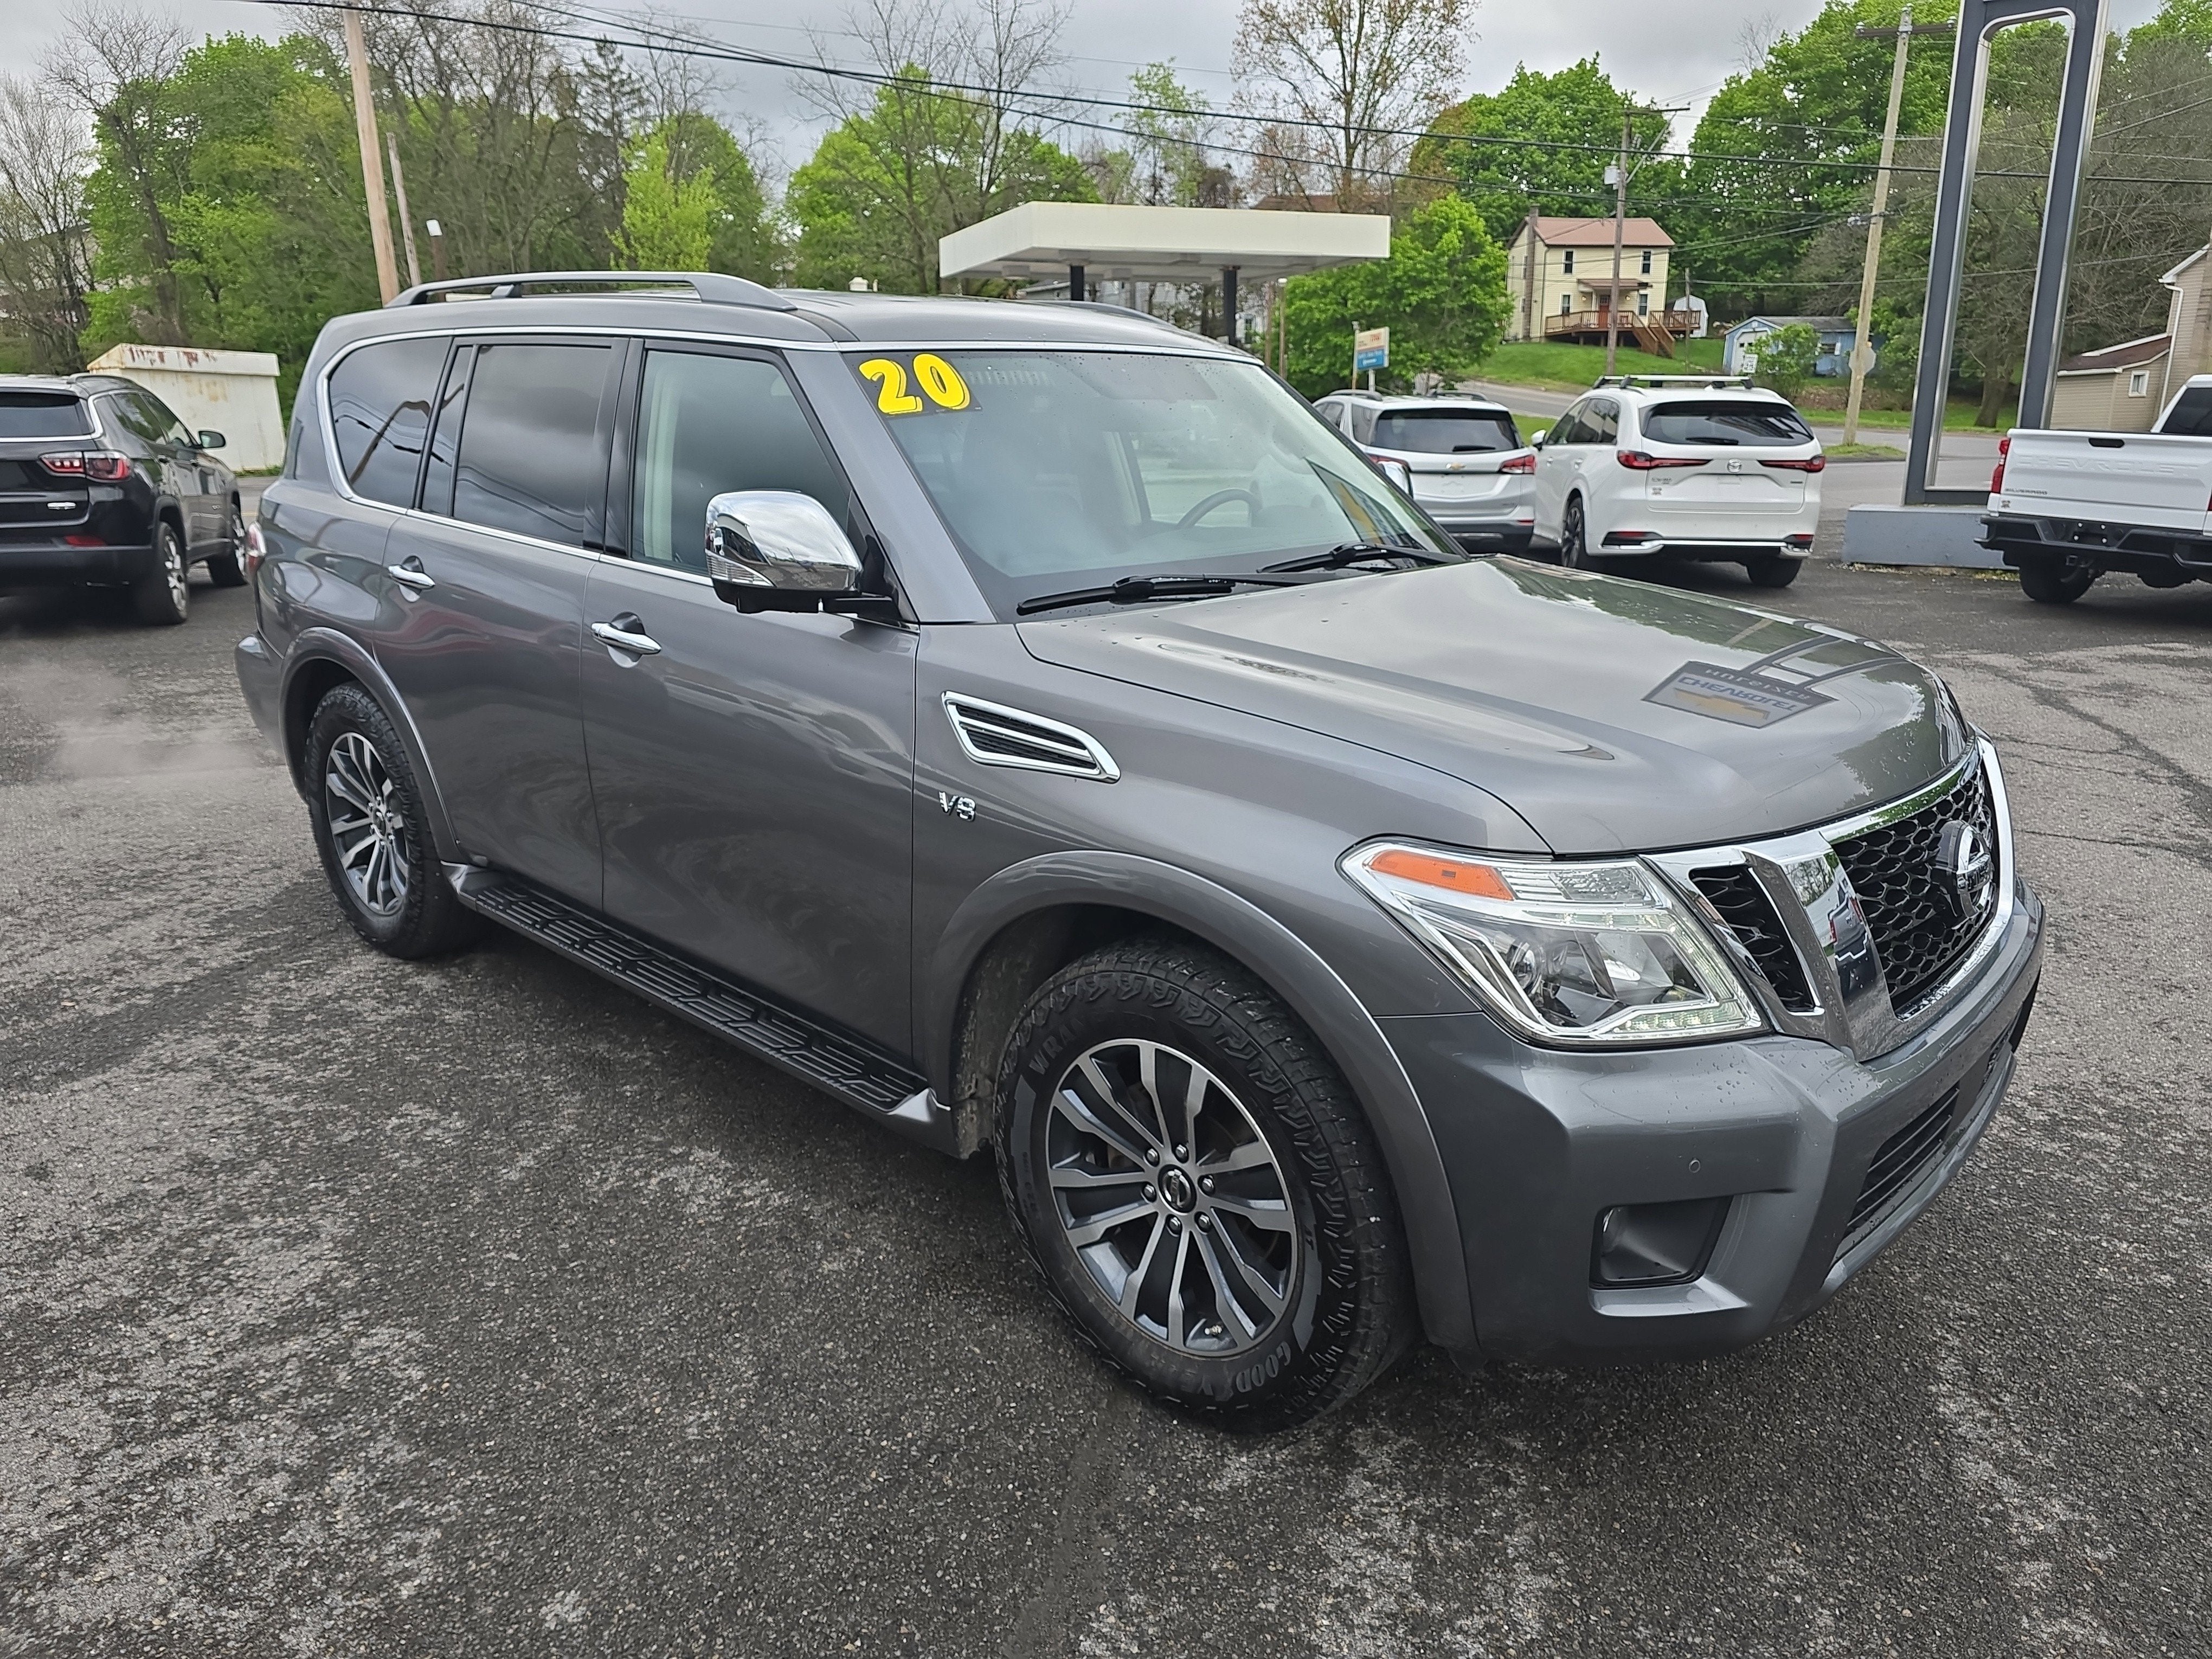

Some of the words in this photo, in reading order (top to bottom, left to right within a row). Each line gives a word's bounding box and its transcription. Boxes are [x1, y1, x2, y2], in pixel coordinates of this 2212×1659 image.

[858, 352, 971, 414] 20
[2017, 454, 2198, 476] CHEVROLET
[938, 791, 976, 822] V8
